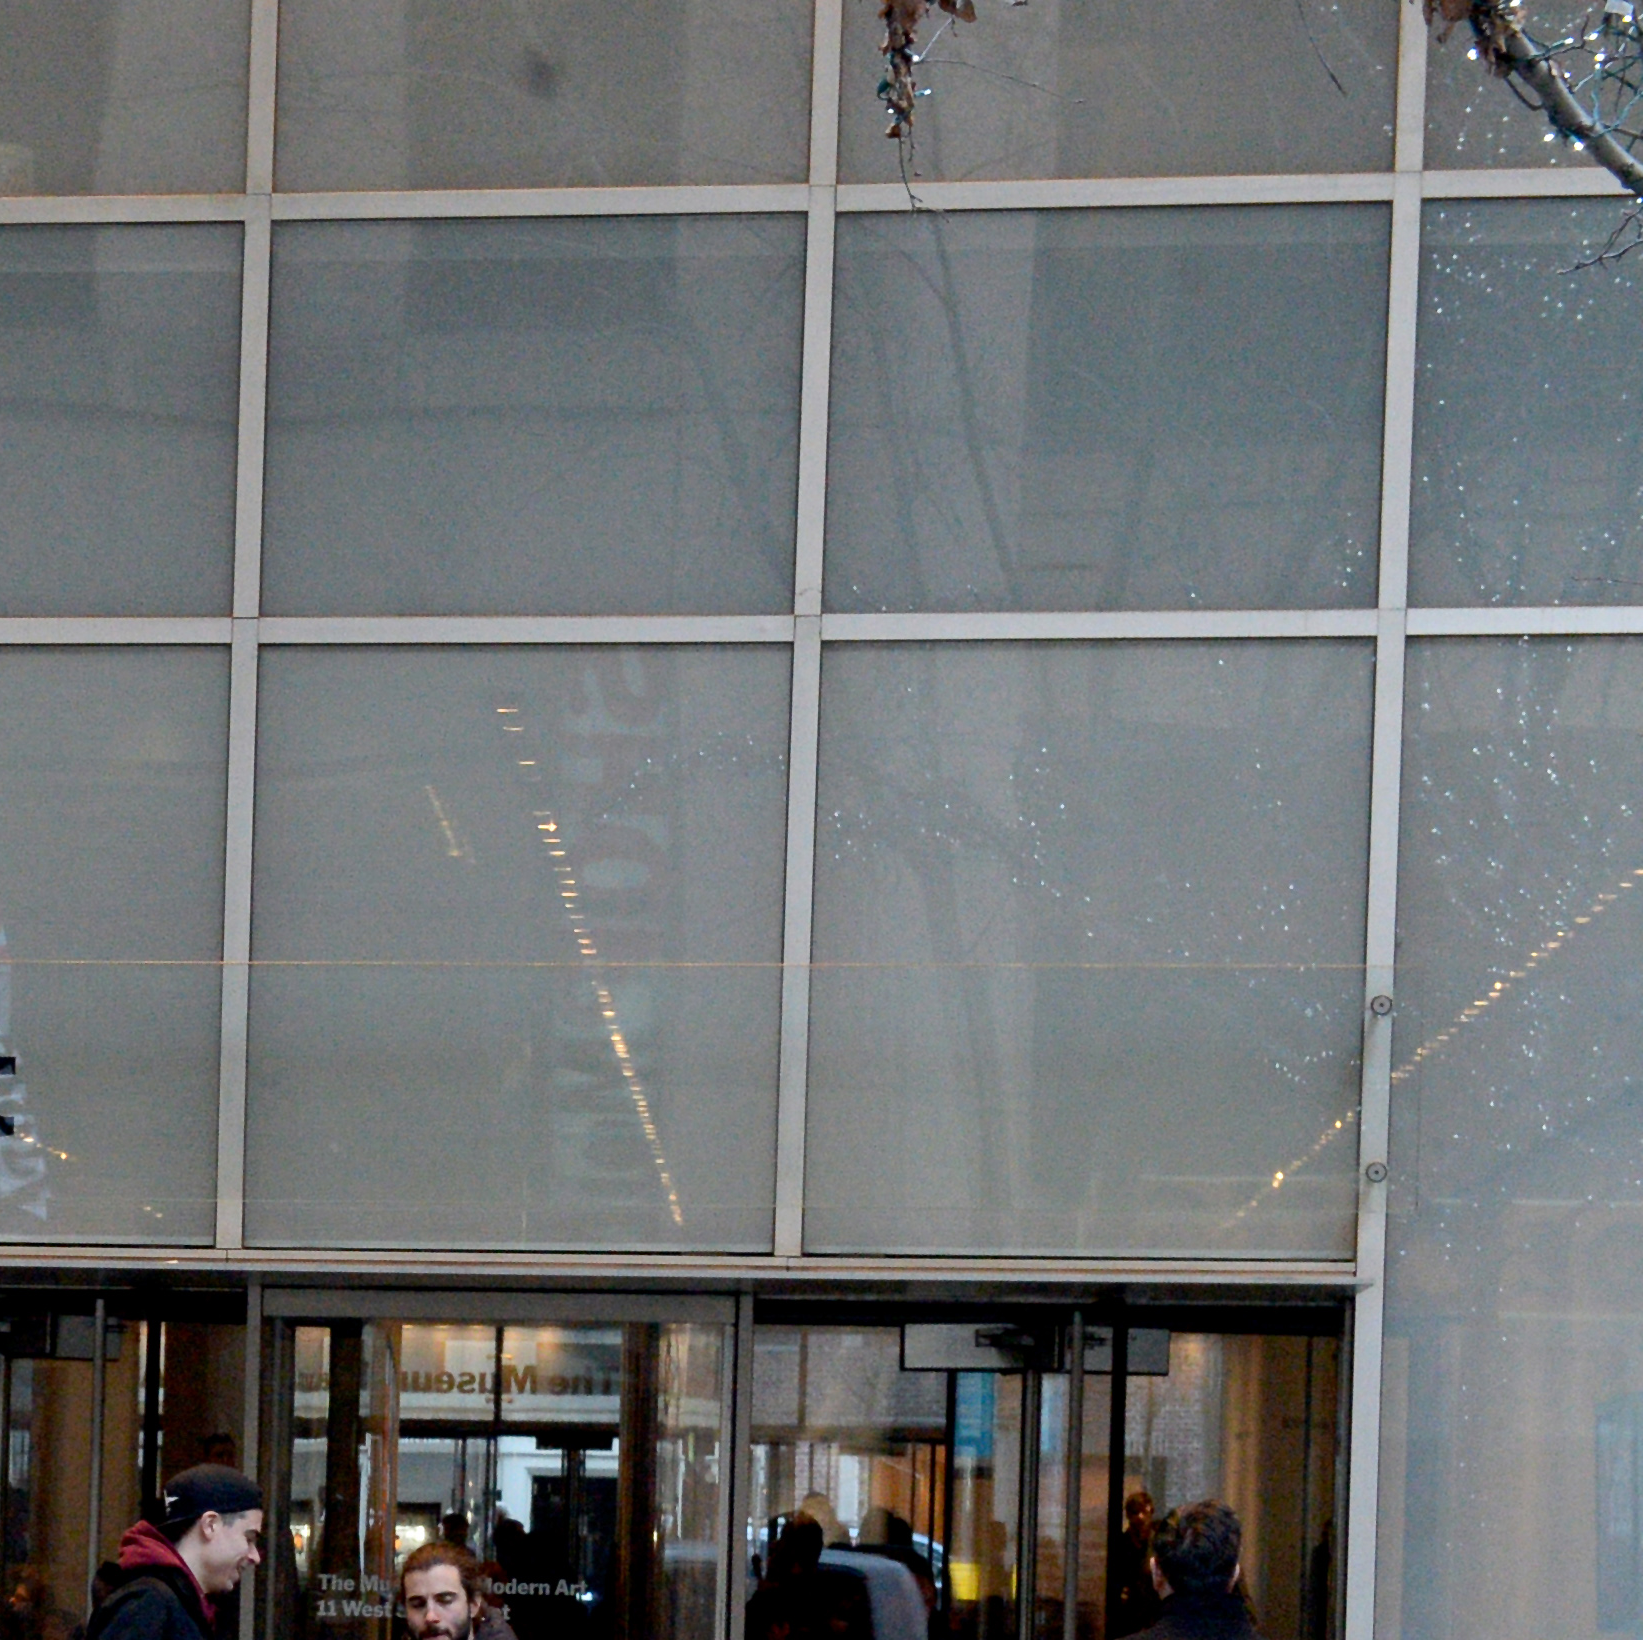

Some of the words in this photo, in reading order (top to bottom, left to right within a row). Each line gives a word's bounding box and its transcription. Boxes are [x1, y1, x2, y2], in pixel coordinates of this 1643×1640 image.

[318, 1573, 355, 1592] The
[486, 1576, 551, 1596] odern
[555, 1578, 589, 1596] Art
[316, 1601, 338, 1617] 11
[342, 1601, 391, 1618] West
